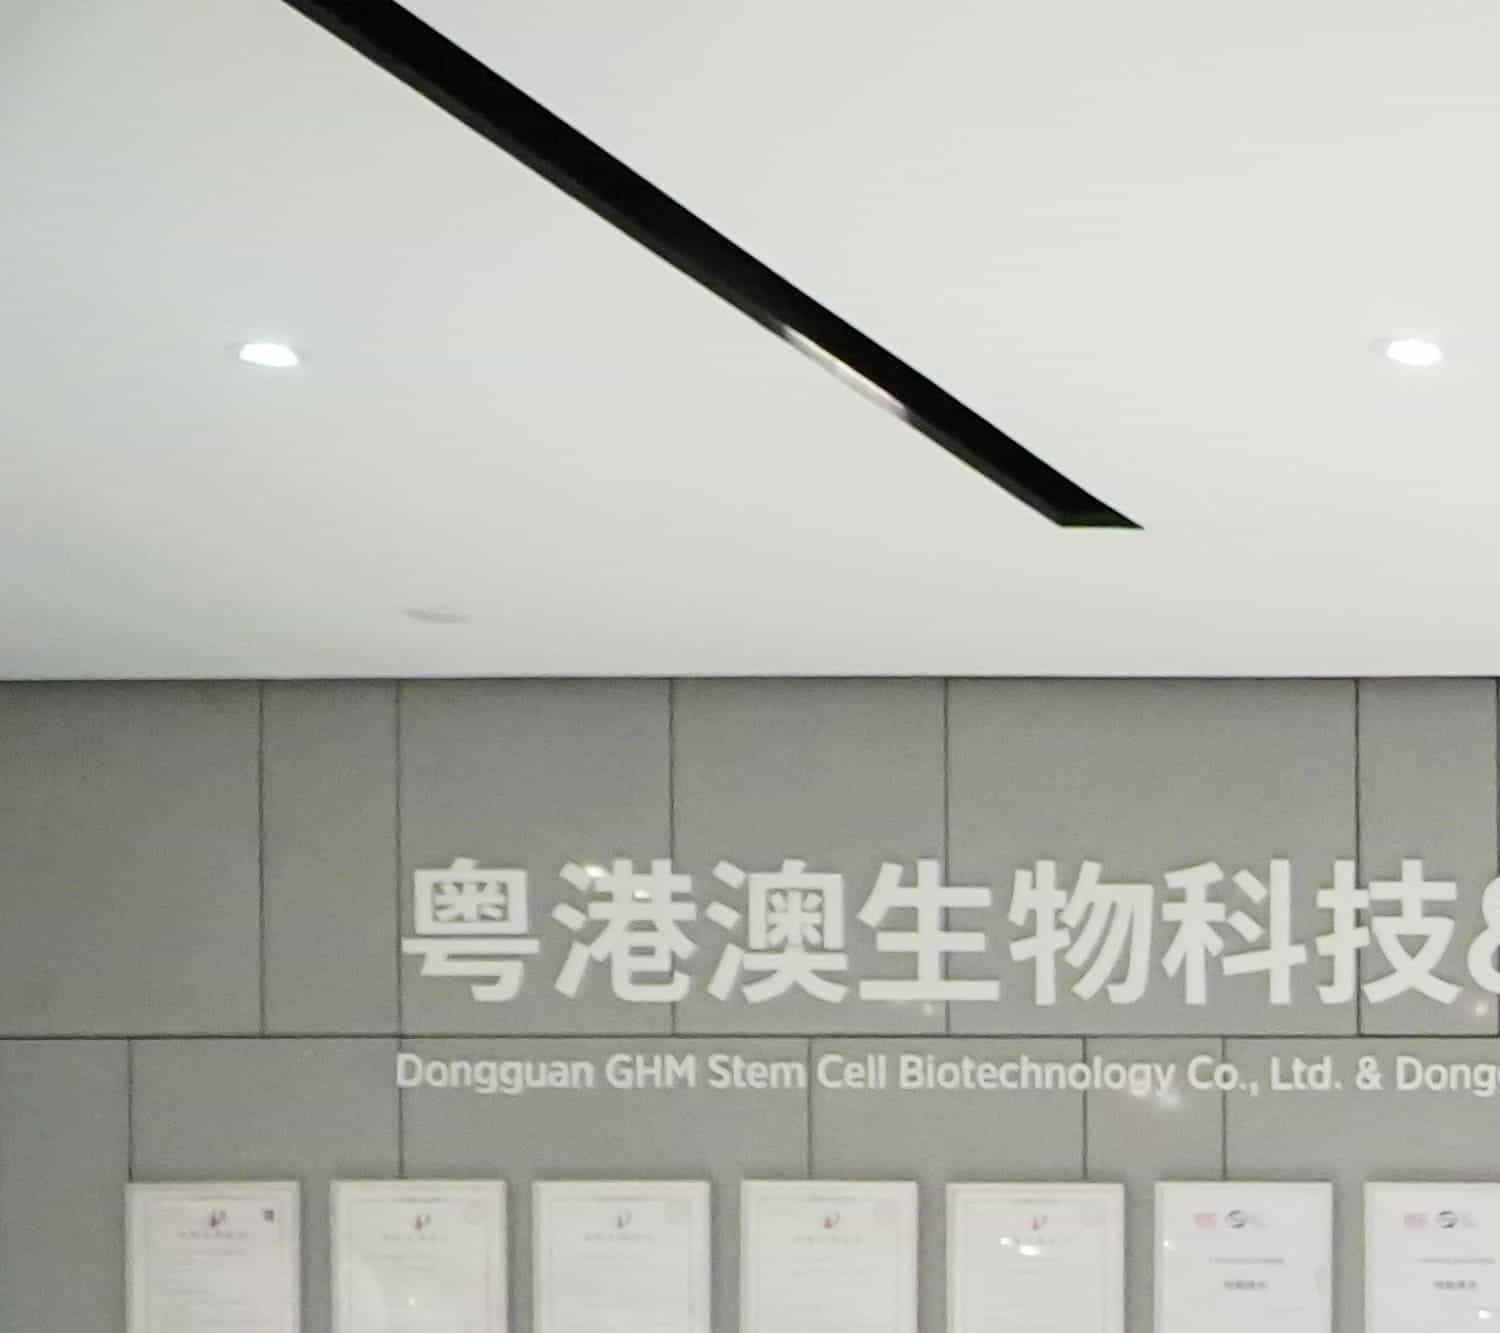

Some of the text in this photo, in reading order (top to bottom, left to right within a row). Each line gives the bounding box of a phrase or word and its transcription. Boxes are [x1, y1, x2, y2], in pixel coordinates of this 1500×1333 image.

[395, 1053, 595, 1095] Dongguan
[605, 1053, 698, 1089] GHM
[707, 1053, 806, 1089] Stem
[817, 1054, 887, 1089] Cell
[899, 1054, 1178, 1097] Biotechnology
[1187, 1055, 1259, 1097] Co.,
[1271, 1055, 1342, 1091] Ltd.
[1355, 1055, 1383, 1091] &
